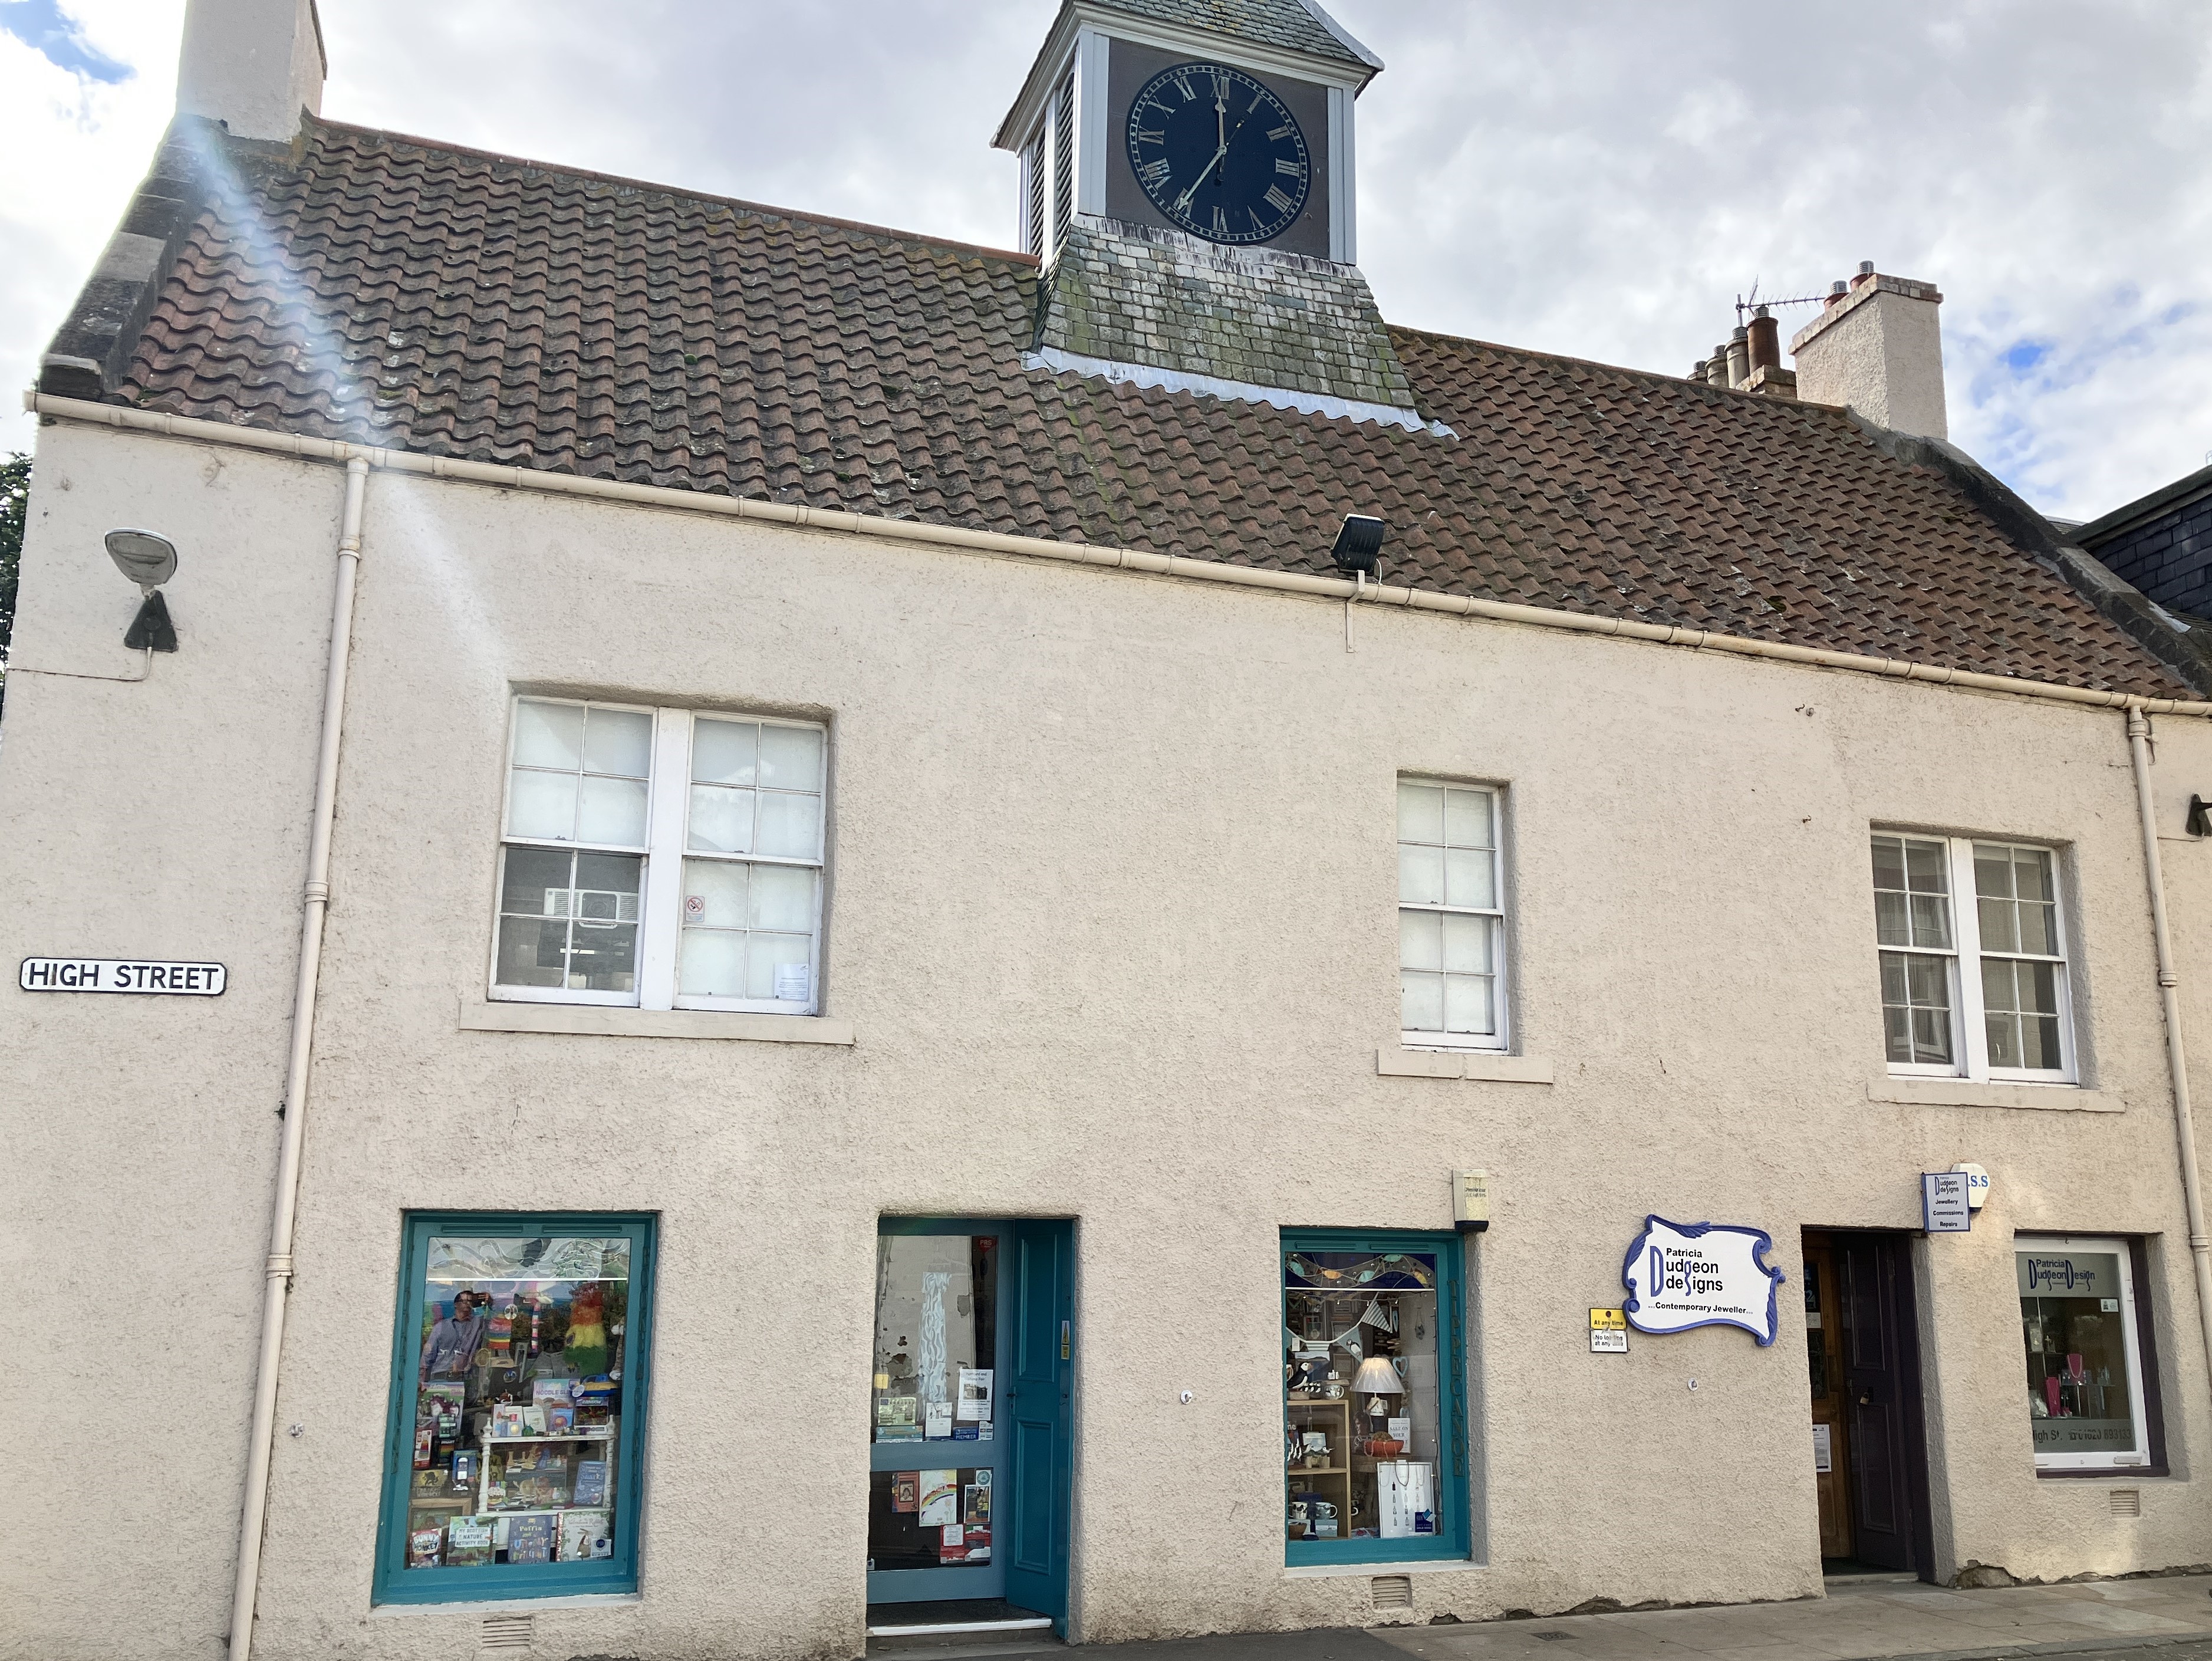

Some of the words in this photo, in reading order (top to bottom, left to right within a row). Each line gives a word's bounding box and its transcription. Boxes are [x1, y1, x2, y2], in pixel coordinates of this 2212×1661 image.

[28, 963, 99, 986] HIGH
[114, 965, 218, 990] STREET
[1666, 1248, 1702, 1258] Patricia
[2036, 1259, 2065, 1268] Patricia
[2028, 1259, 2066, 1291] Dudgeon
[2051, 1429, 2062, 1440] St.
